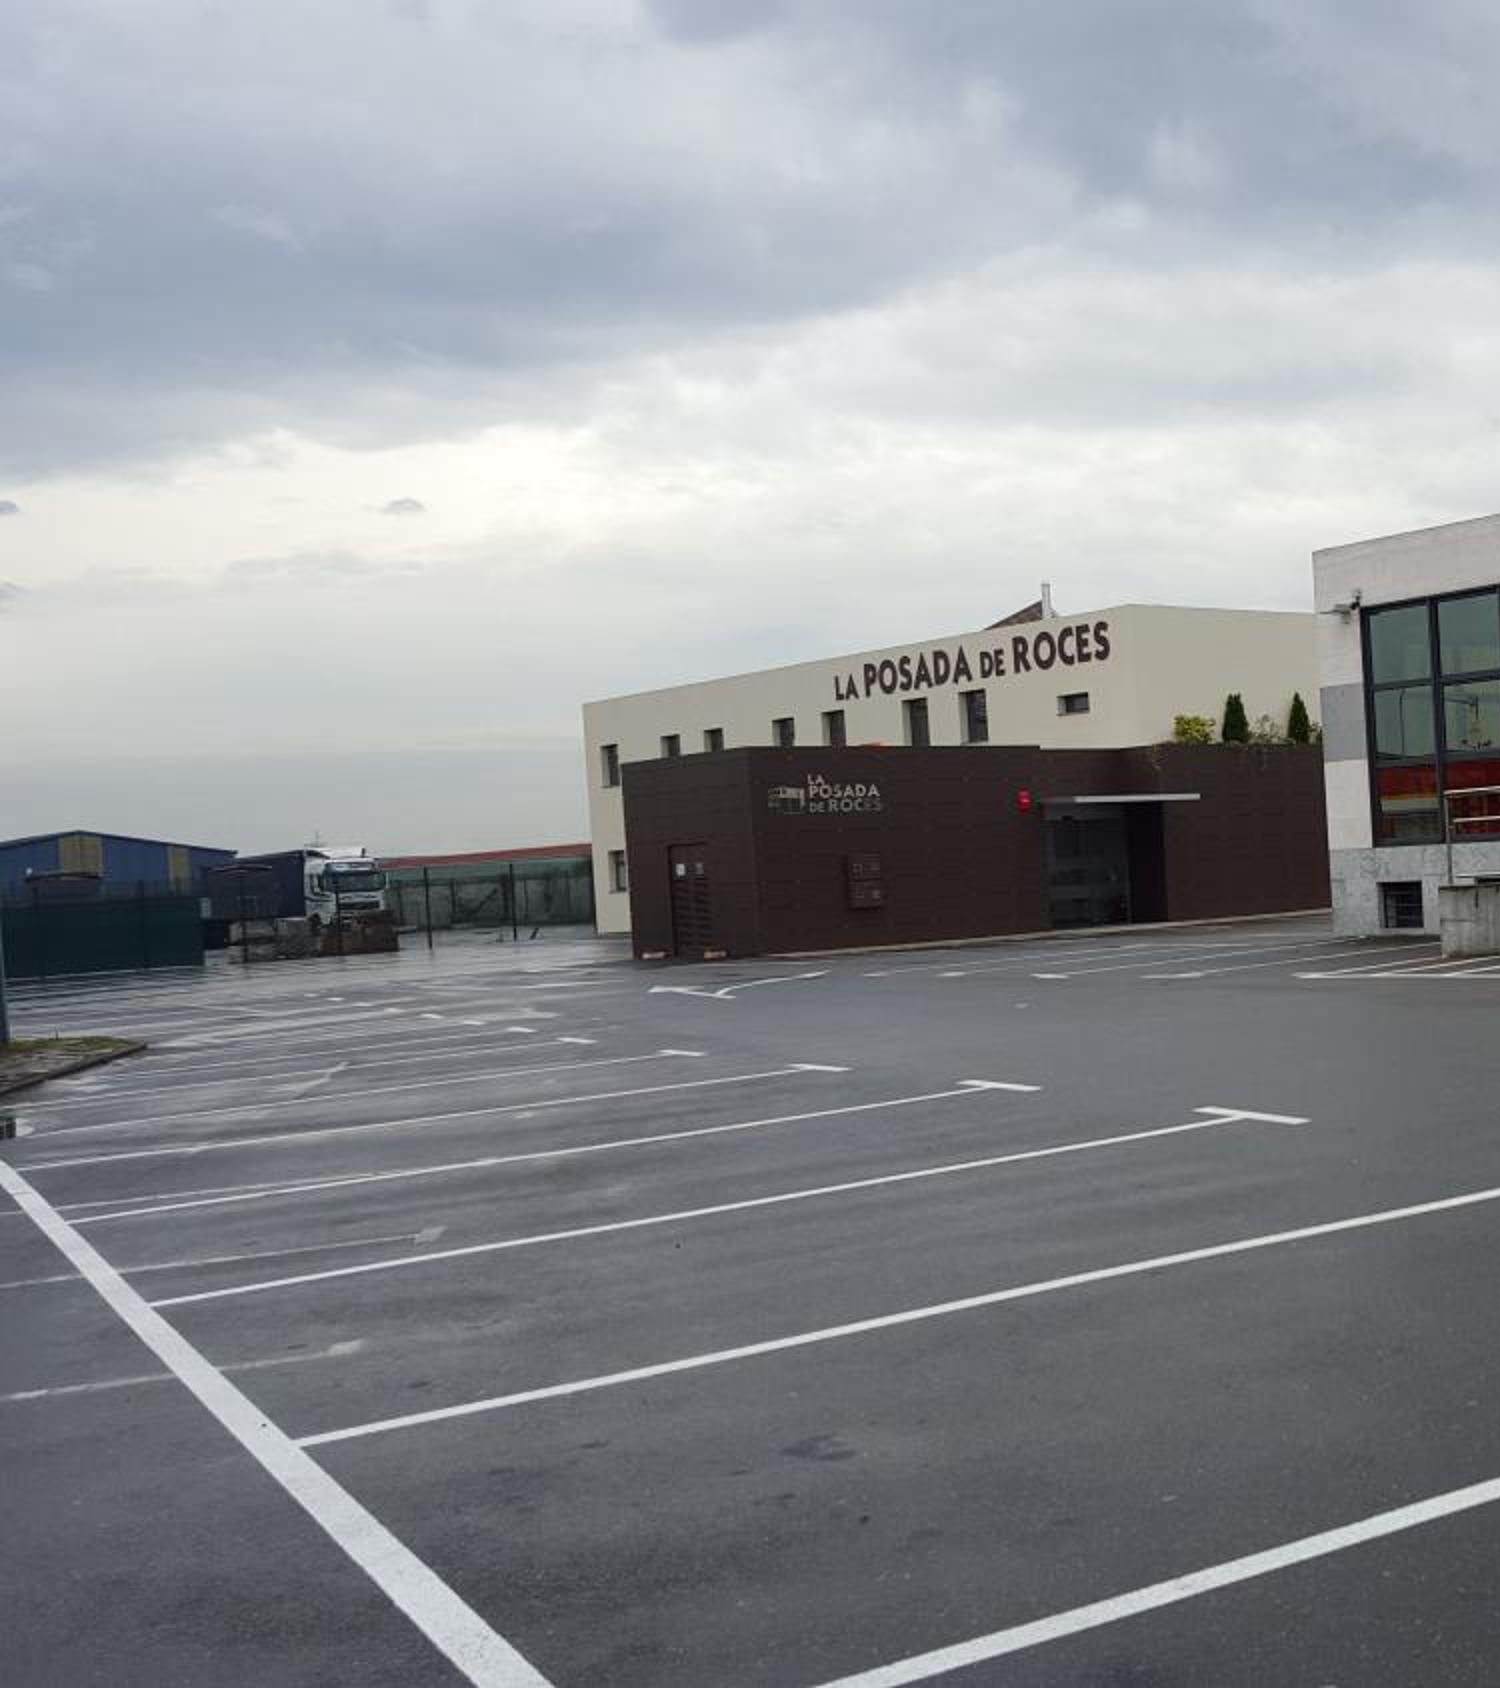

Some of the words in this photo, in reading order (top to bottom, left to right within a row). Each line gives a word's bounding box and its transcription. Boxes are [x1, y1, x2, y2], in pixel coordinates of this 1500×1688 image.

[834, 674, 859, 700] LA
[863, 645, 973, 697] POSADA
[979, 648, 1006, 679] DE
[1012, 621, 1111, 674] ROCES
[807, 774, 825, 785] LA
[809, 783, 881, 798] POSADA
[809, 801, 825, 813] DE
